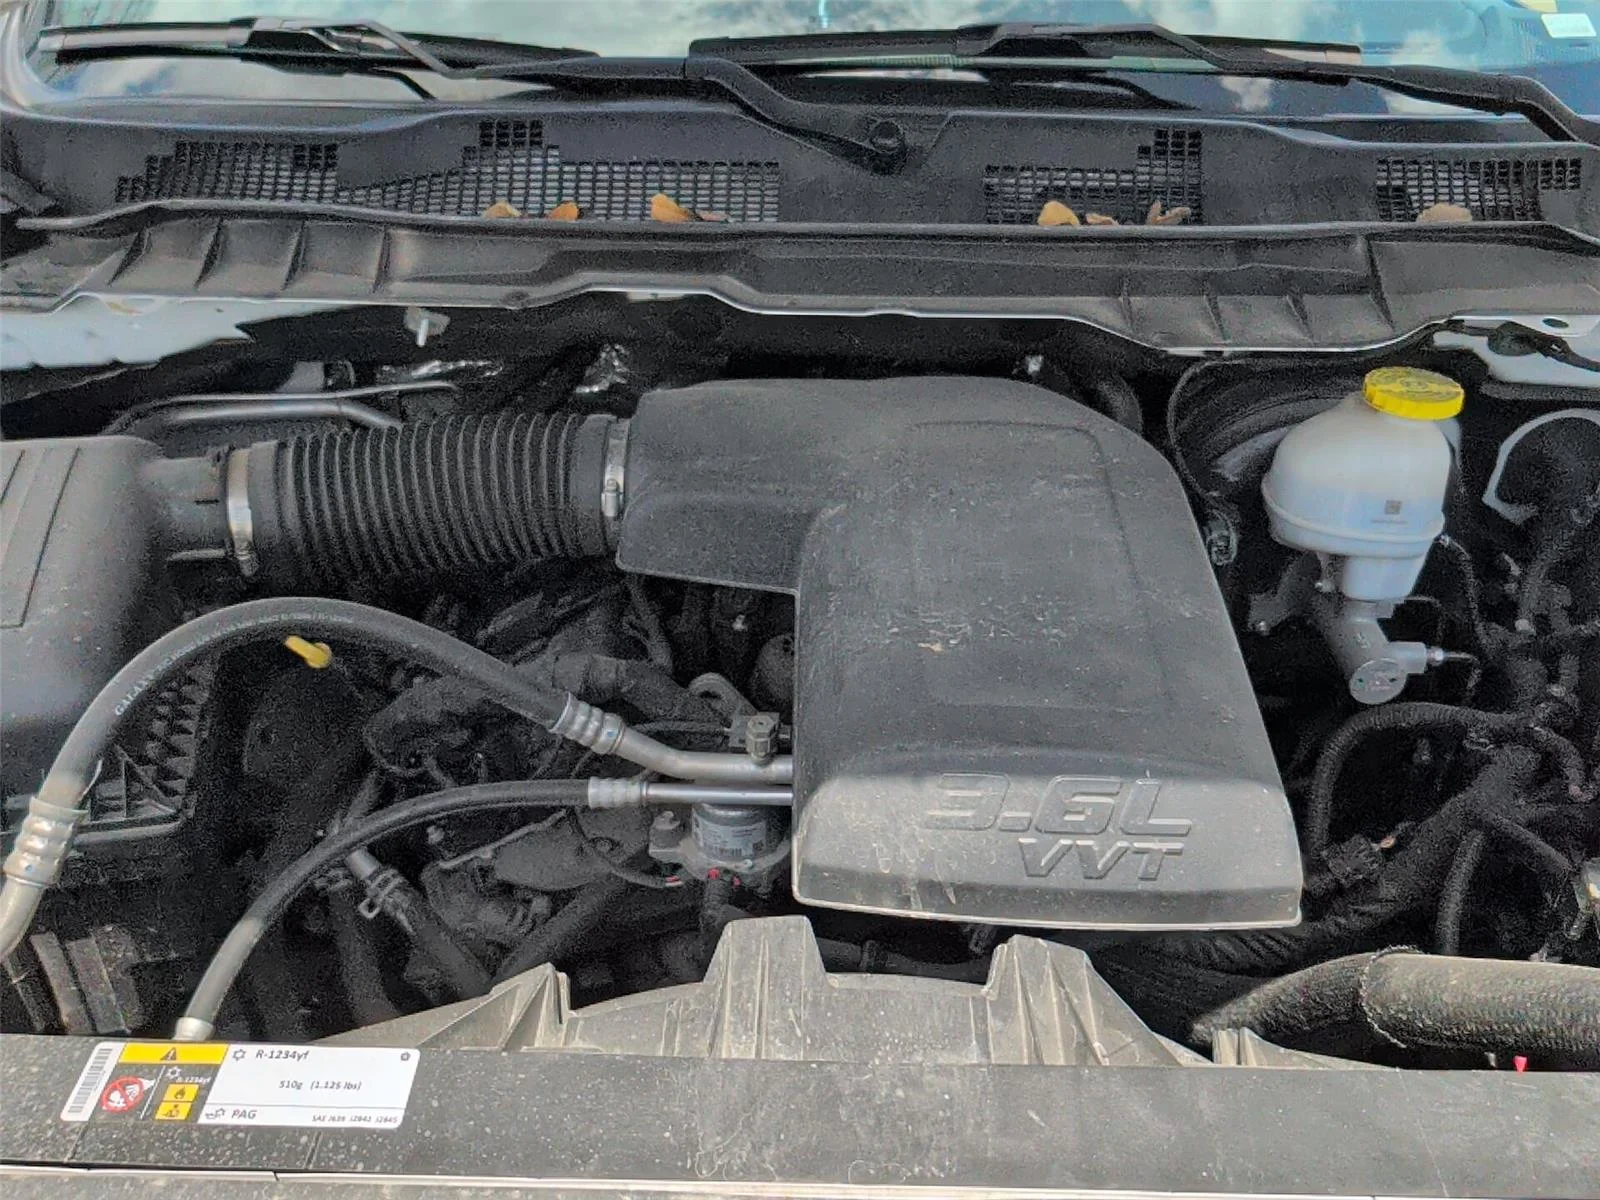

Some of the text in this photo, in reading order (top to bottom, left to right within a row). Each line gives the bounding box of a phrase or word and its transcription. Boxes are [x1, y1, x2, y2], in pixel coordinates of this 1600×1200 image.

[924, 773, 1193, 836] 3.6L
[1018, 838, 1184, 881] VVT
[255, 1049, 310, 1061] R-1234yf
[279, 1080, 363, 1091] 510g (1.125 lbs)
[231, 1110, 257, 1120] PAG
